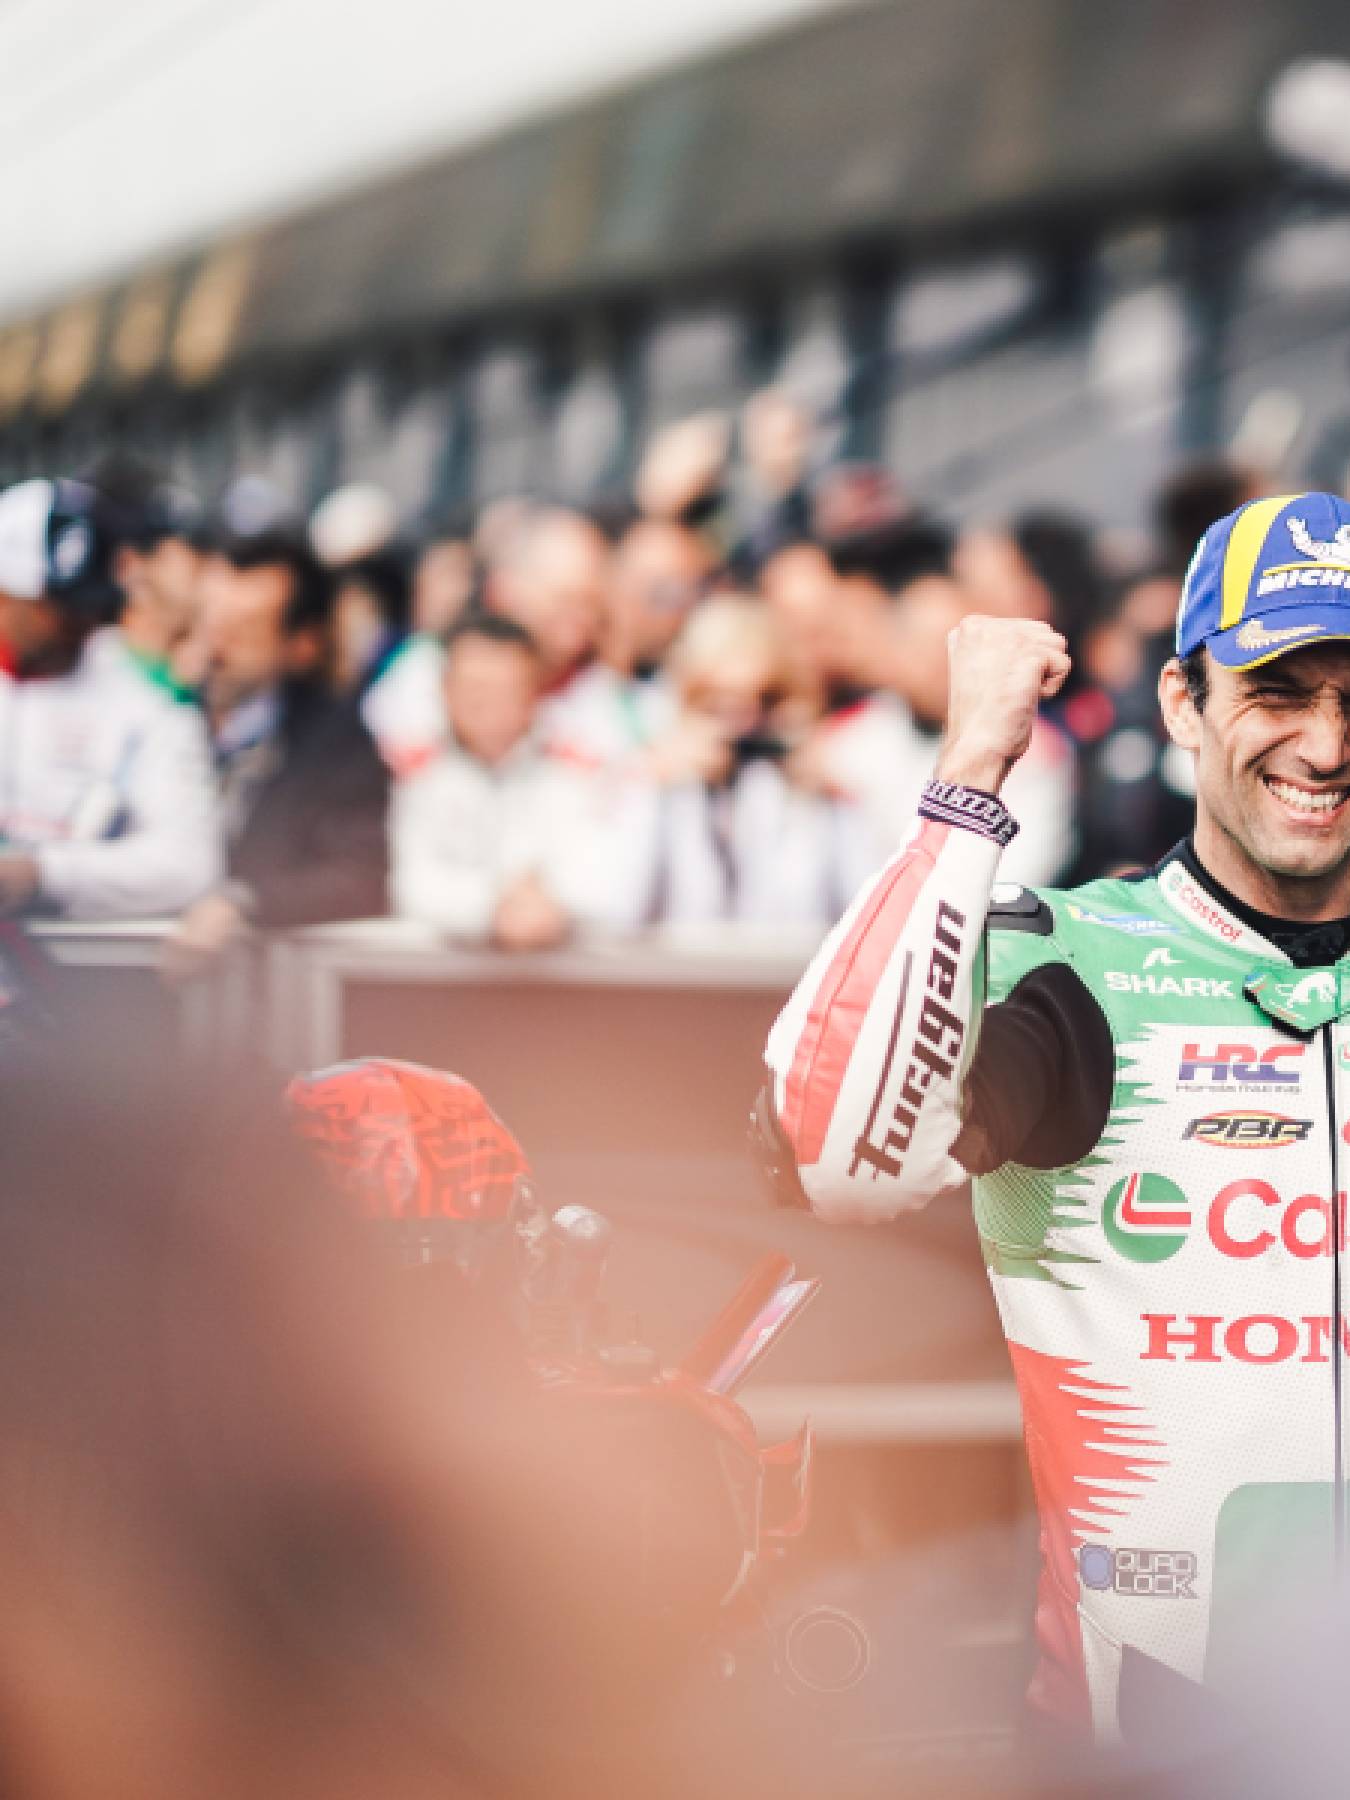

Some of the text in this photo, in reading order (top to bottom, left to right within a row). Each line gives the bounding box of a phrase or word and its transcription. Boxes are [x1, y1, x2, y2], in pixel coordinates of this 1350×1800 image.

[1103, 970, 1236, 998] SHARK
[1178, 1043, 1306, 1083] HRC
[1181, 1117, 1315, 1141] PBR
[1116, 1551, 1193, 1573] QUAD
[1116, 1571, 1197, 1599] LOCK
